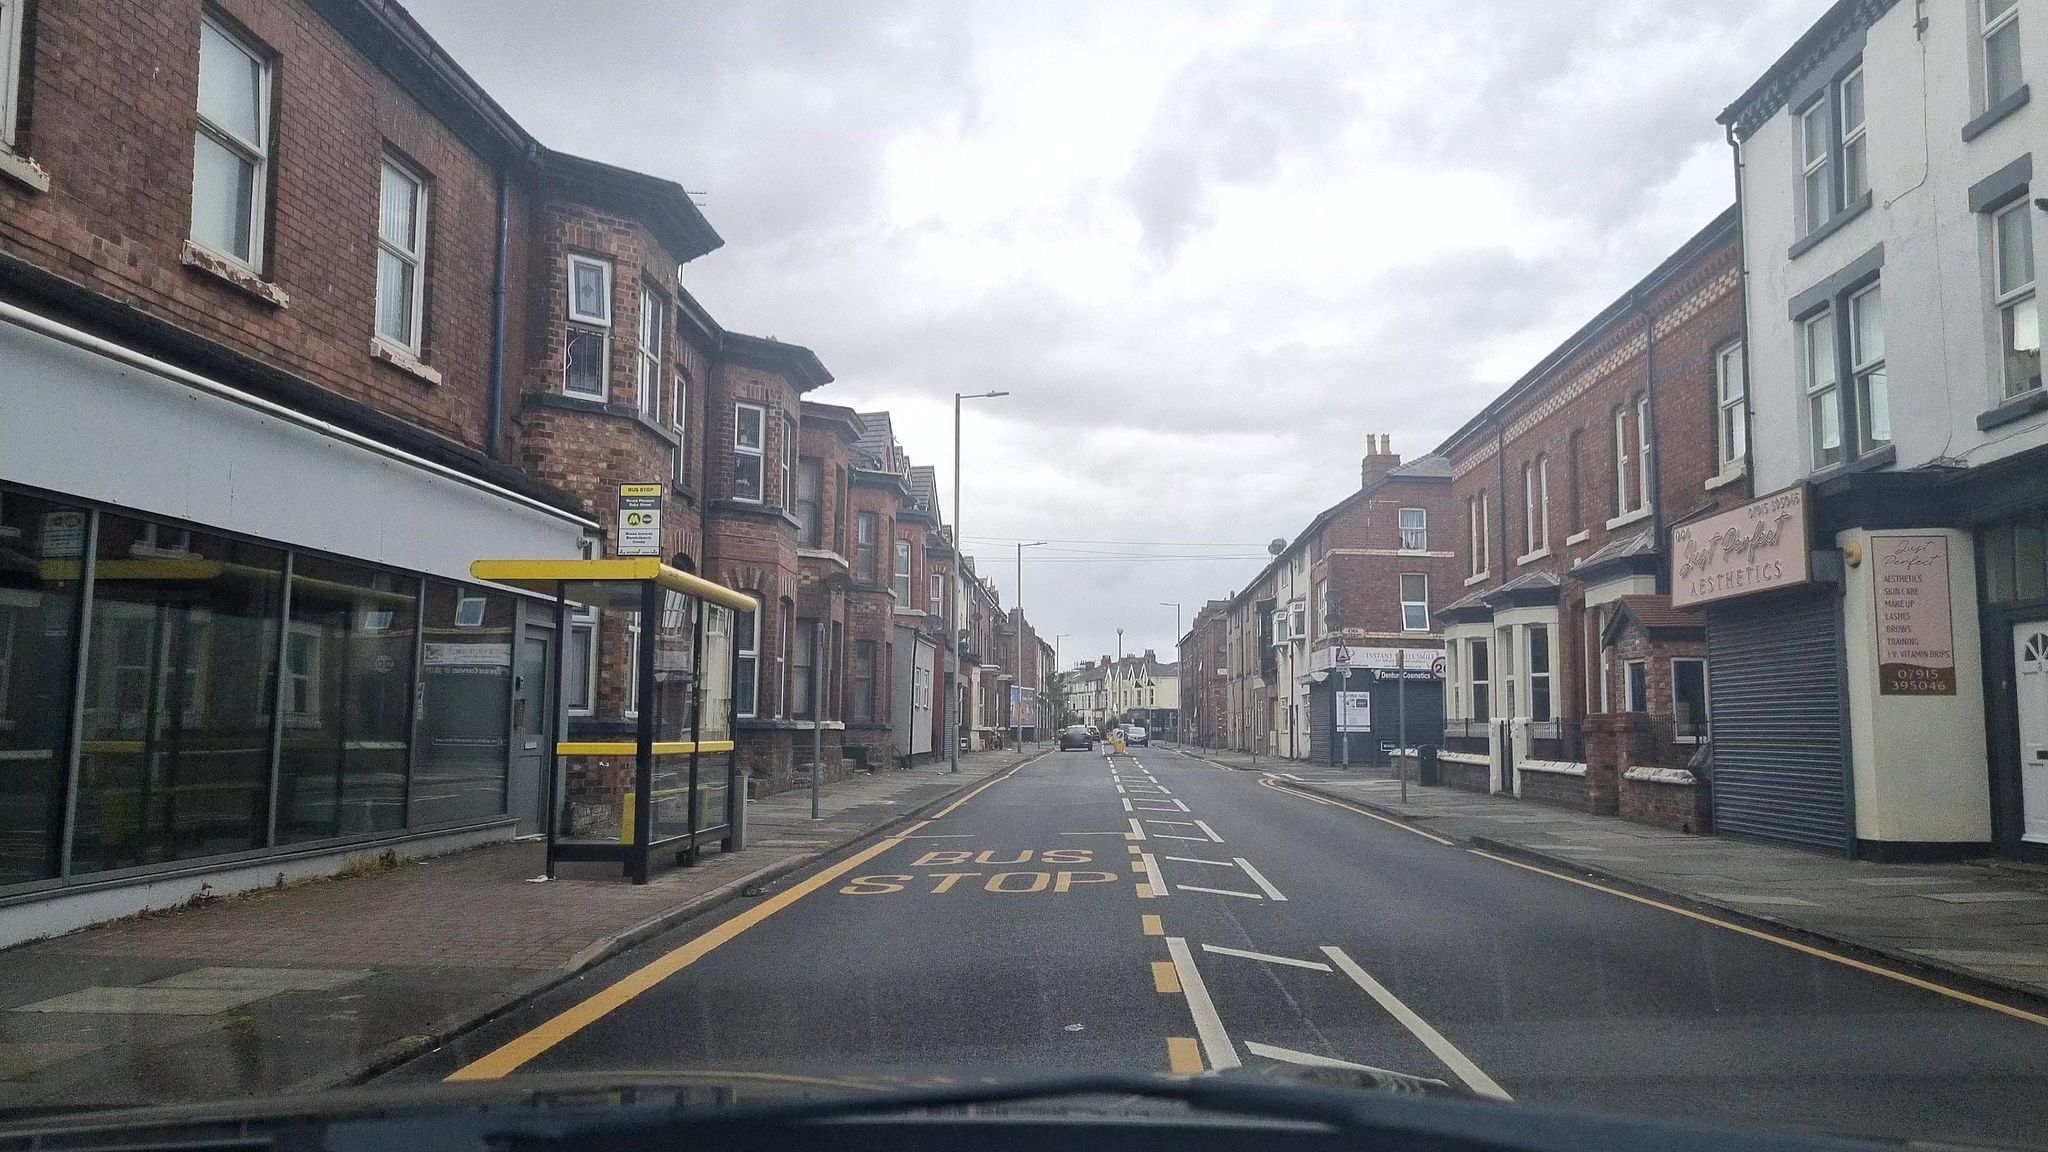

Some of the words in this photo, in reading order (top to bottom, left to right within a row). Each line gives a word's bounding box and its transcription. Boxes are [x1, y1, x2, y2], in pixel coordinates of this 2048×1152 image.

[1680, 532, 1723, 577] Just
[1721, 512, 1791, 563] Perfect
[1895, 540, 1935, 555] Just
[1882, 554, 1941, 571] Perfect
[1690, 560, 1783, 597] AESTHETICS
[1883, 574, 1923, 583] AESTHETICS
[1901, 587, 1920, 596] CARE
[1884, 600, 1904, 609] MAKE
[1905, 600, 1916, 609] UP
[1885, 612, 1911, 621] LASHES
[1886, 625, 1912, 633] BROWS
[1887, 637, 1919, 646] TRAINING
[1900, 650, 1928, 658] VITAMIN
[1929, 650, 1950, 659] DRIPS
[1403, 671, 1431, 679] Cosmetics
[1897, 669, 1938, 679] 07915
[1891, 681, 1946, 691] 395046
[910, 849, 1093, 867] BUS
[839, 871, 1119, 895] STOP
